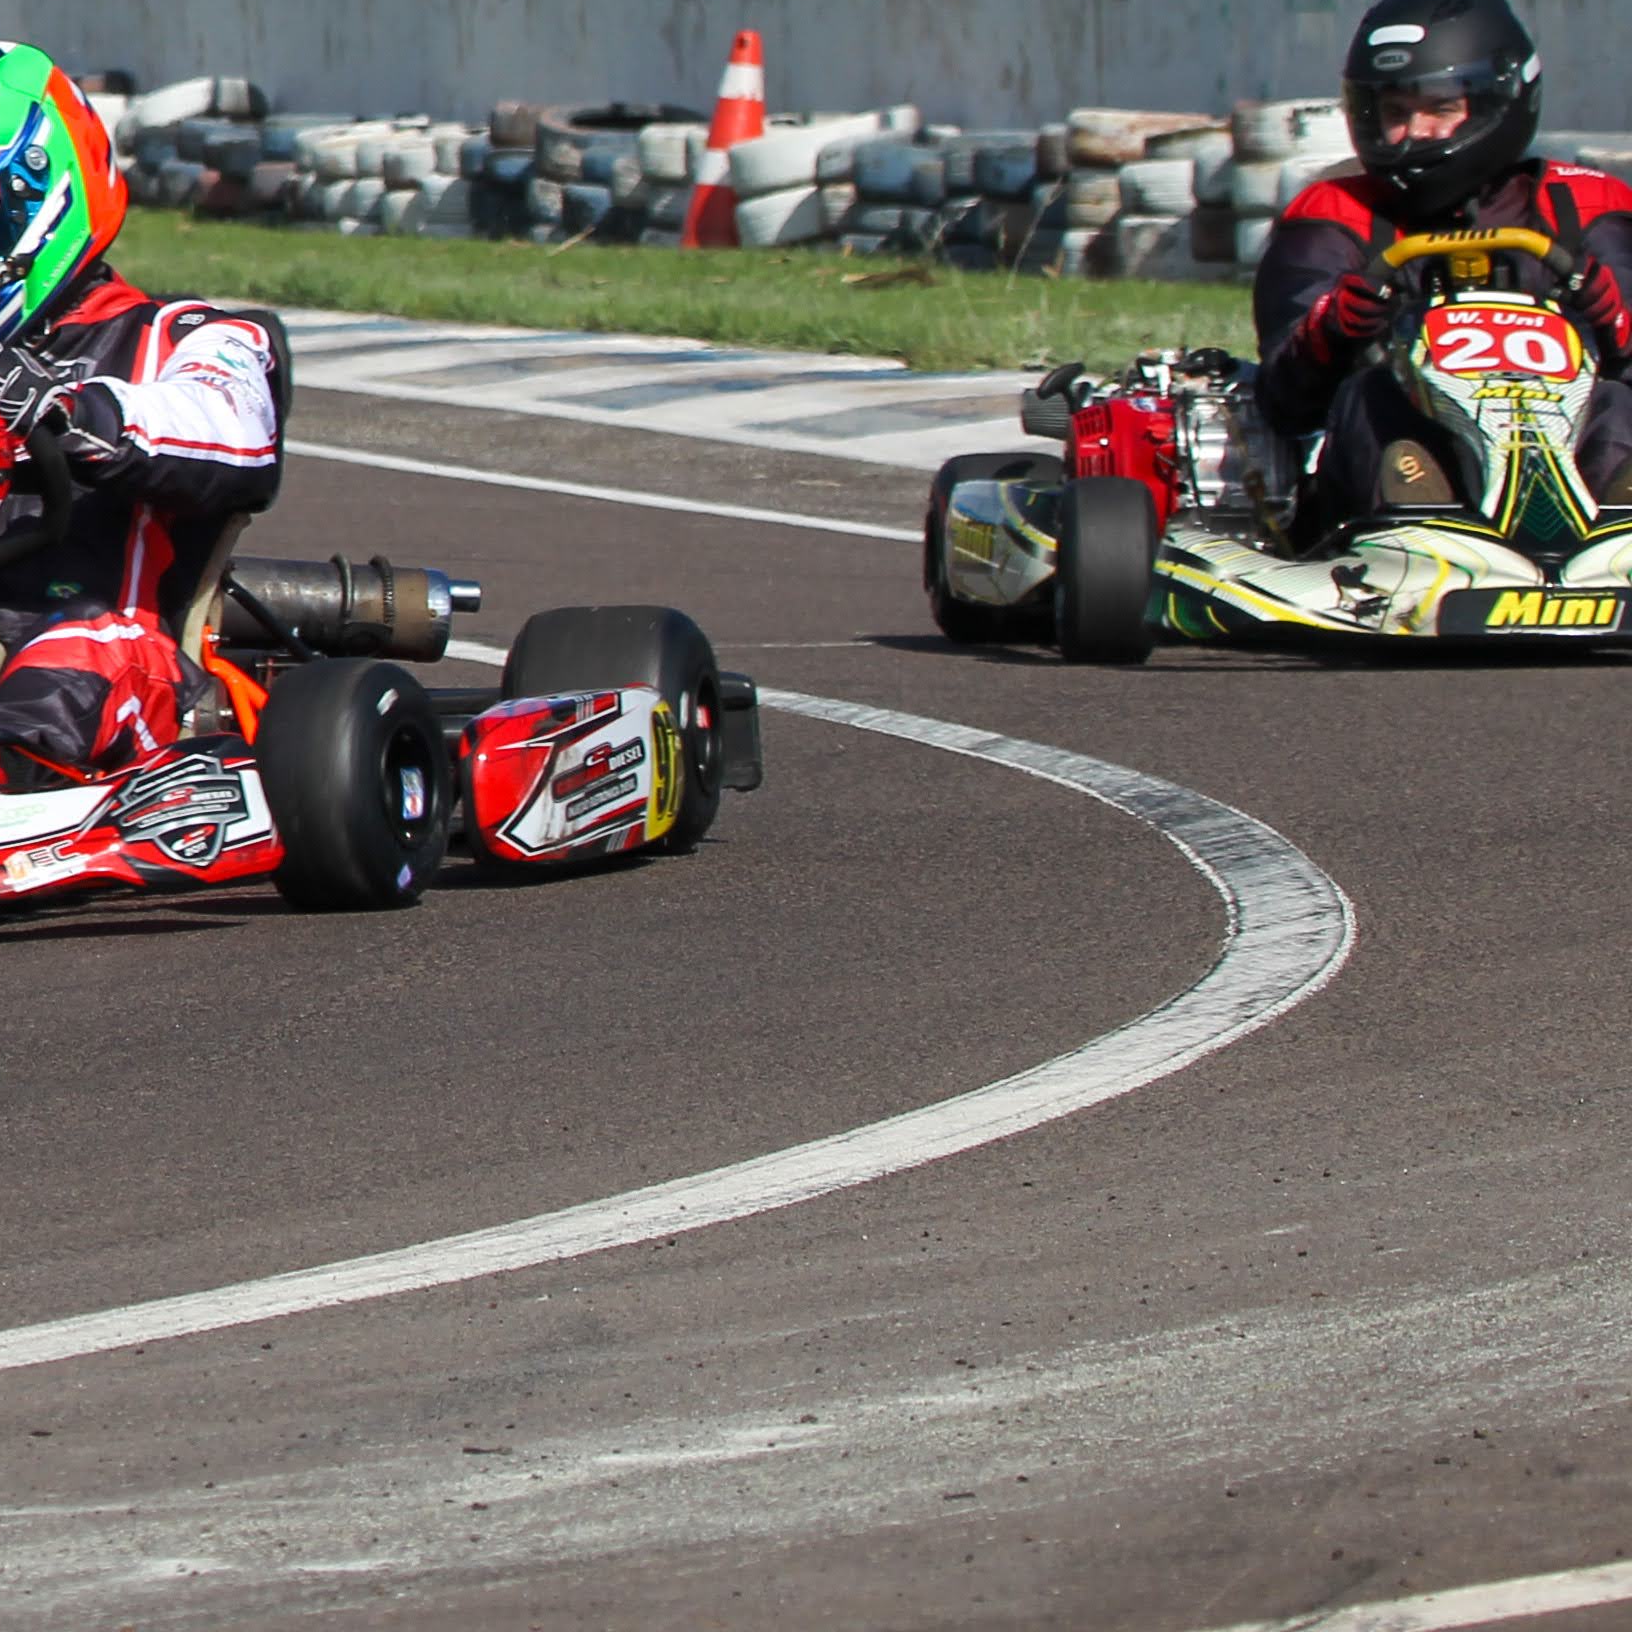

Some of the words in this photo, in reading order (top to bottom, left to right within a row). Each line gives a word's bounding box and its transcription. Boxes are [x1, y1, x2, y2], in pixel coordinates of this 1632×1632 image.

[1446, 312, 1484, 325] W.
[1492, 312, 1545, 328] Uni
[1436, 328, 1568, 373] 20
[1471, 386, 1564, 402] Mini
[1486, 591, 1617, 627] Mini
